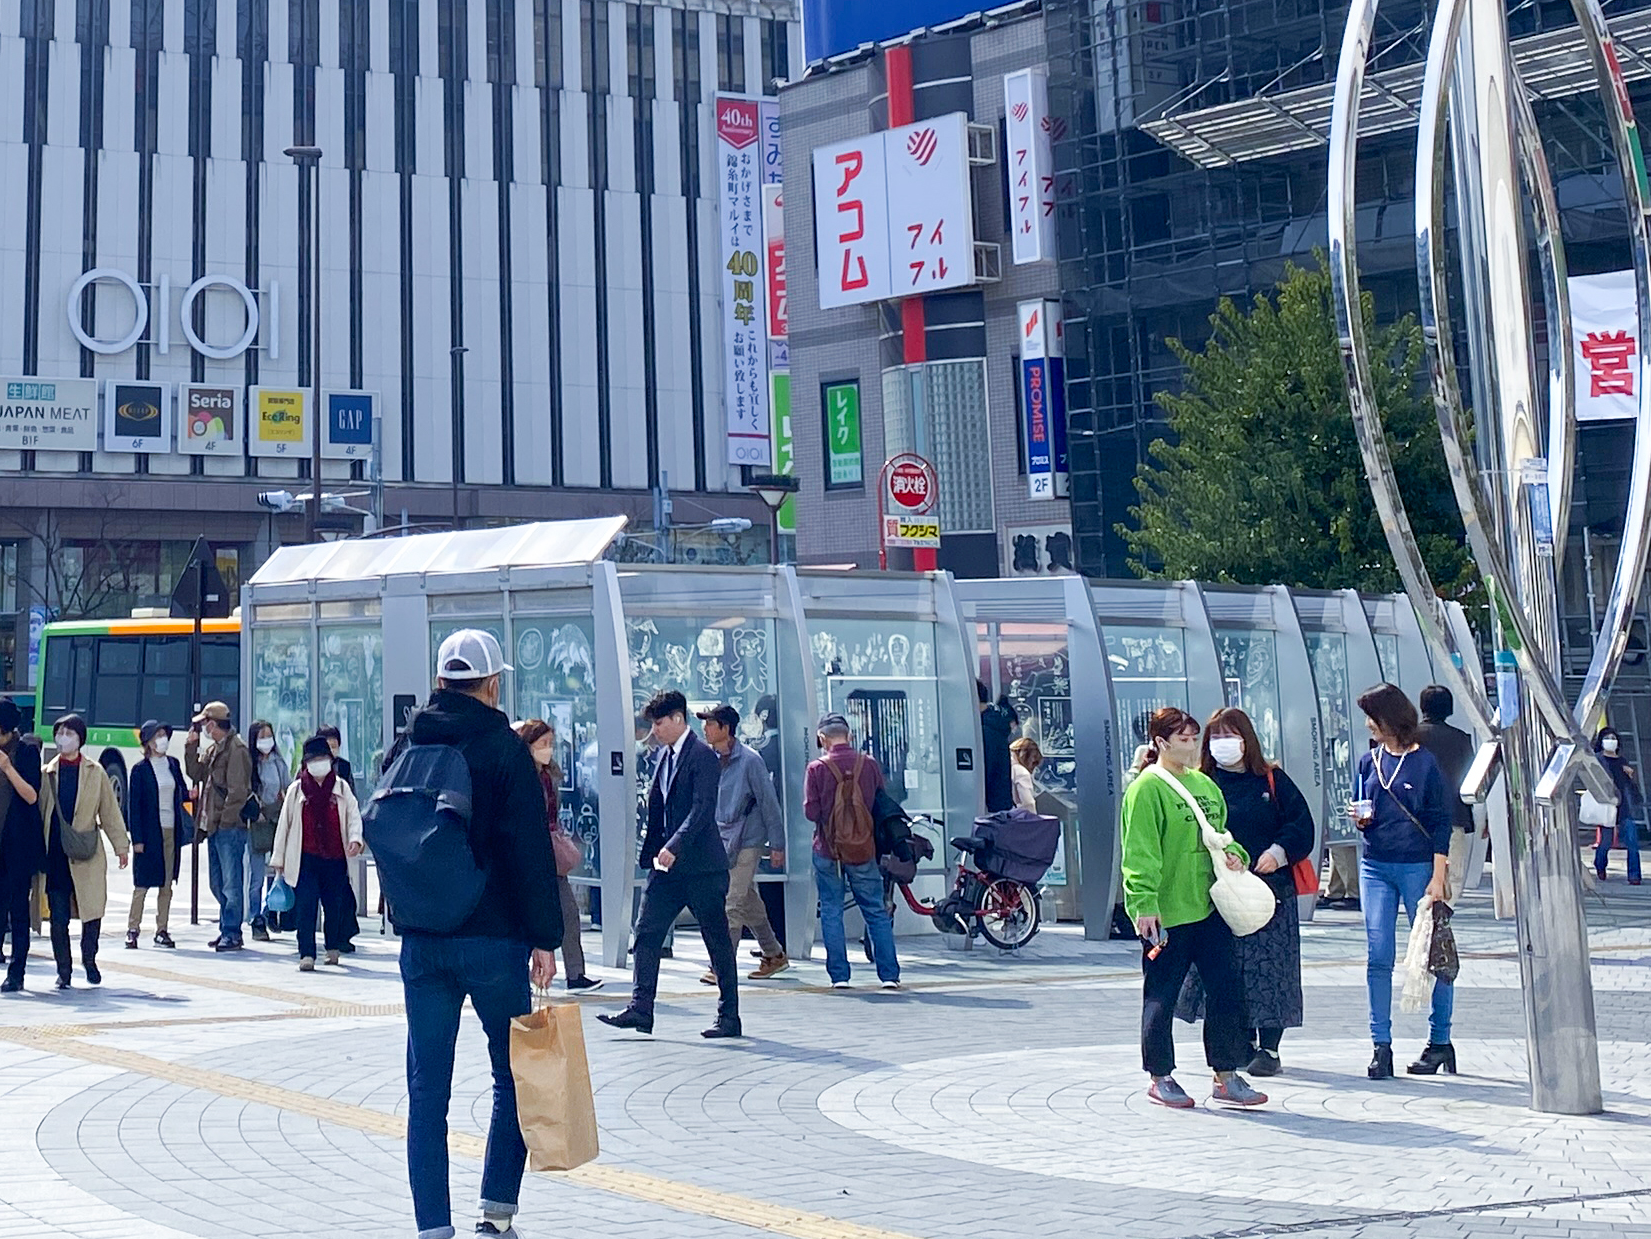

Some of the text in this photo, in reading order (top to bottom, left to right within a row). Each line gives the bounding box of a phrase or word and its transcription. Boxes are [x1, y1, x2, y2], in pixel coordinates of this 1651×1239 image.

[721, 108, 753, 128] 40th
[741, 153, 753, 236] おかげさまで
[835, 150, 869, 291] アコム
[1580, 331, 1636, 397] 営
[7, 383, 56, 401] 生鮮館
[191, 392, 231, 409] Seria
[50, 407, 90, 421] MEAT
[1029, 366, 1045, 443] PROMISE
[338, 409, 363, 430] GAP
[836, 390, 849, 445] レイク
[22, 435, 39, 446] B1F
[132, 439, 143, 448] 6F
[205, 441, 216, 450] 4F
[276, 444, 286, 453] 5F
[893, 475, 927, 495] 消火栓
[1034, 478, 1048, 493] 2F
[900, 525, 938, 538] フクシマ
[1104, 720, 1112, 766] SMOKING
[1310, 717, 1319, 760] SMOKING
